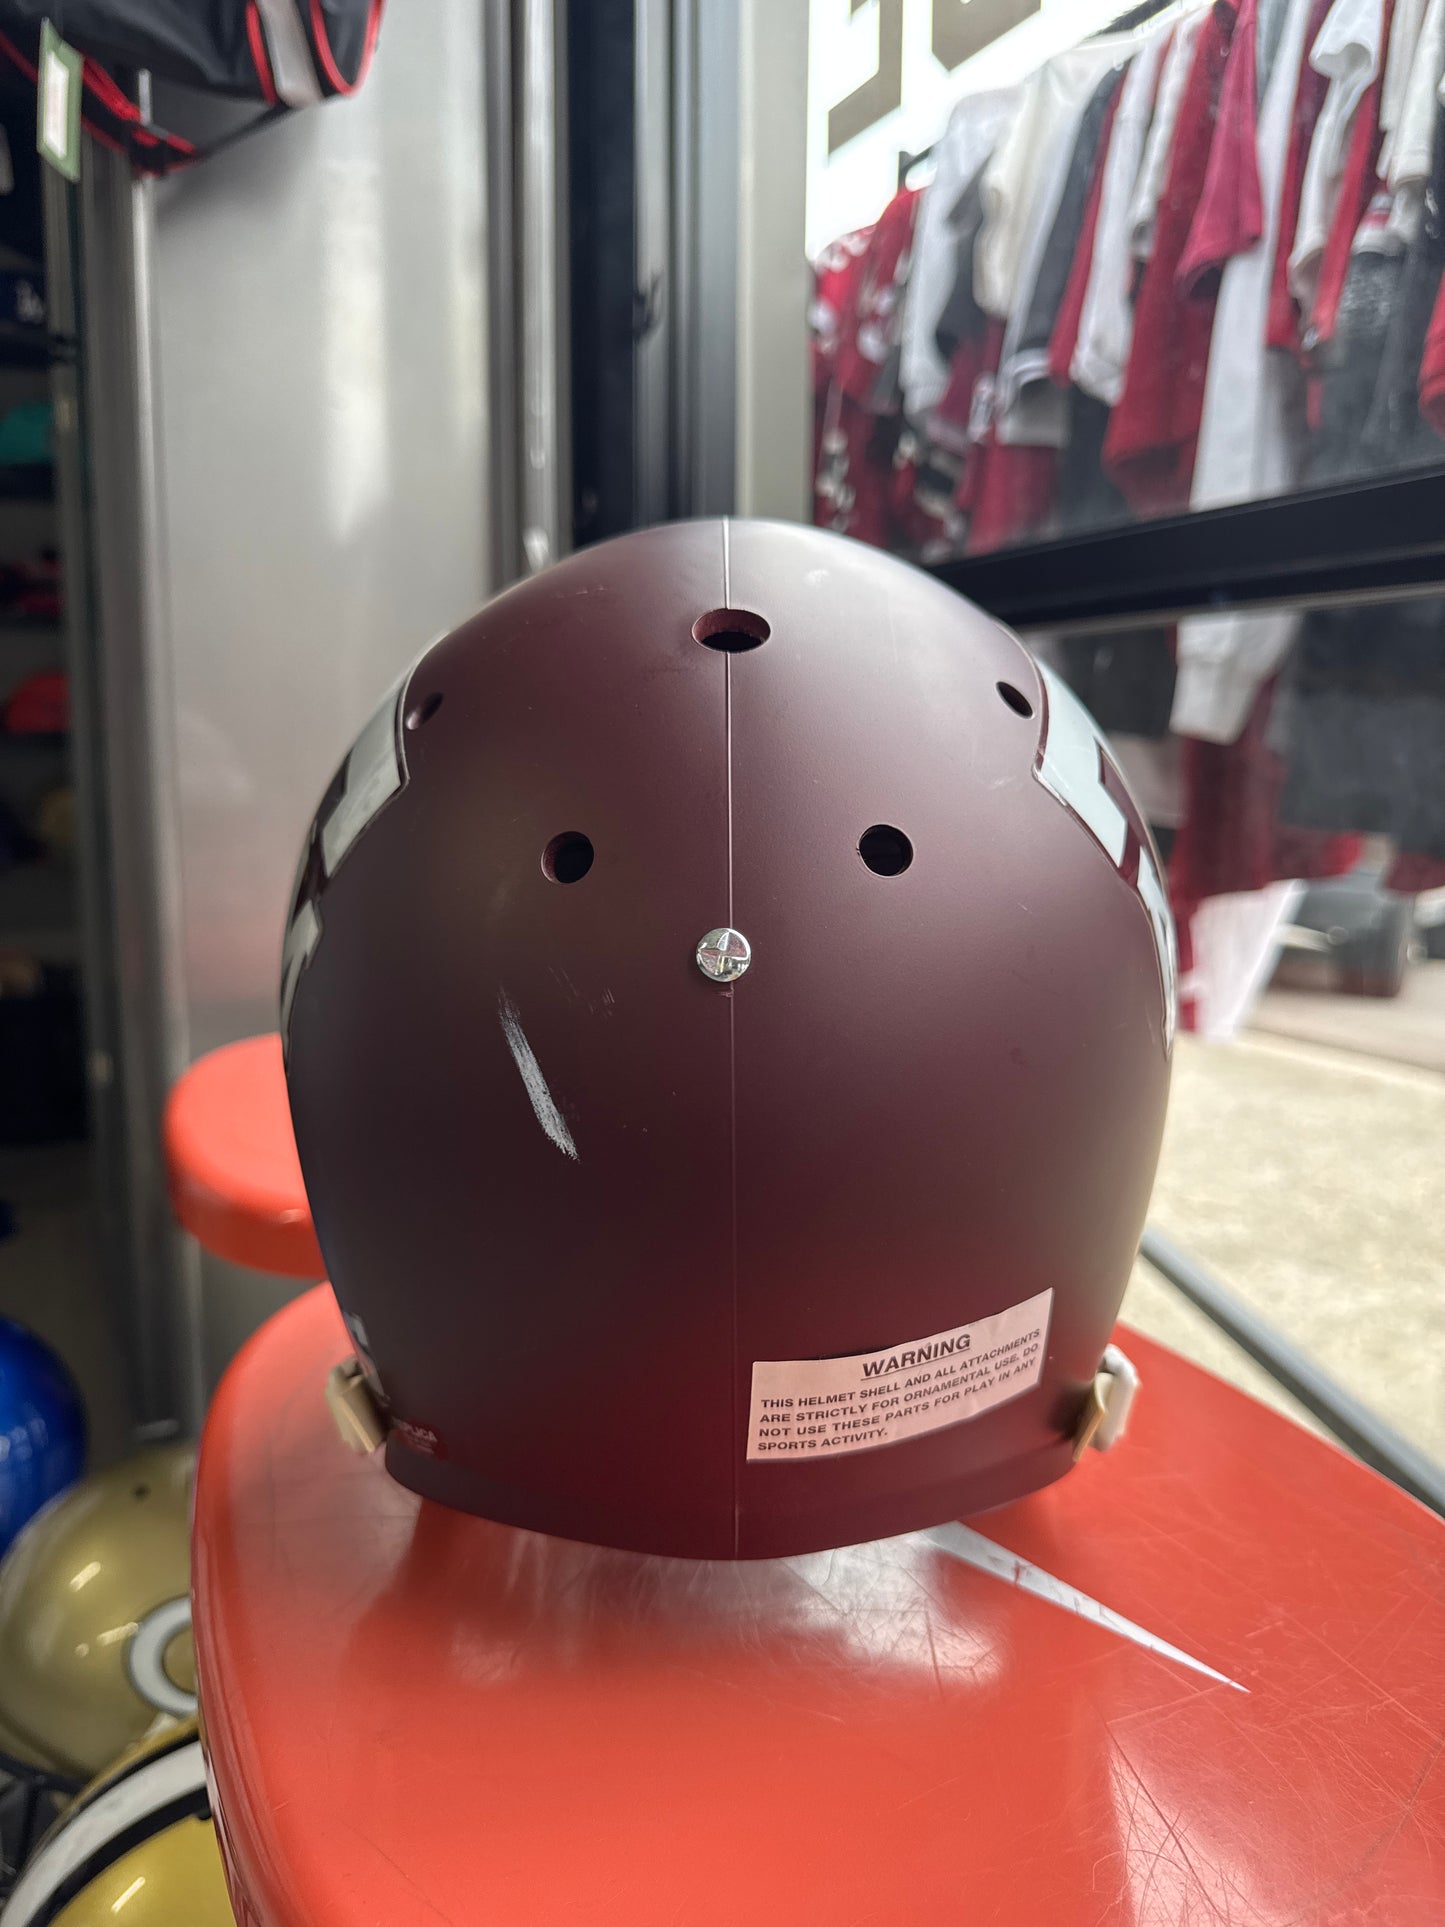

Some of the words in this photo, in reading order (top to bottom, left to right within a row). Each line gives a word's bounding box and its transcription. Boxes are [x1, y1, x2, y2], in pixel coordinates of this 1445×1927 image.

[760, 1413, 791, 1423] ARE
[796, 1404, 868, 1421] STRICTLY
[872, 1397, 899, 1411] FOR
[903, 1368, 991, 1402] ORNAMENTAL
[994, 1354, 1020, 1370] USE.
[1023, 1343, 1039, 1357] DO
[761, 1399, 794, 1408] THIS
[798, 1391, 856, 1407] HELMET
[860, 1382, 901, 1399] SHELL
[904, 1373, 931, 1388] AND
[934, 1364, 956, 1379] ALL
[960, 1328, 1041, 1371] ATTACHMENTS
[862, 1334, 971, 1377] WARNING
[759, 1427, 791, 1437] NOT
[797, 1424, 827, 1436] USE
[832, 1415, 880, 1432] THESE
[885, 1402, 930, 1422] PARTS
[934, 1391, 960, 1407] FOR
[964, 1378, 996, 1396] PLAY
[998, 1370, 1010, 1382] IN
[1013, 1357, 1037, 1375] ANY
[758, 1439, 817, 1451] SPORTS
[821, 1427, 888, 1447] ACTIVITY.
